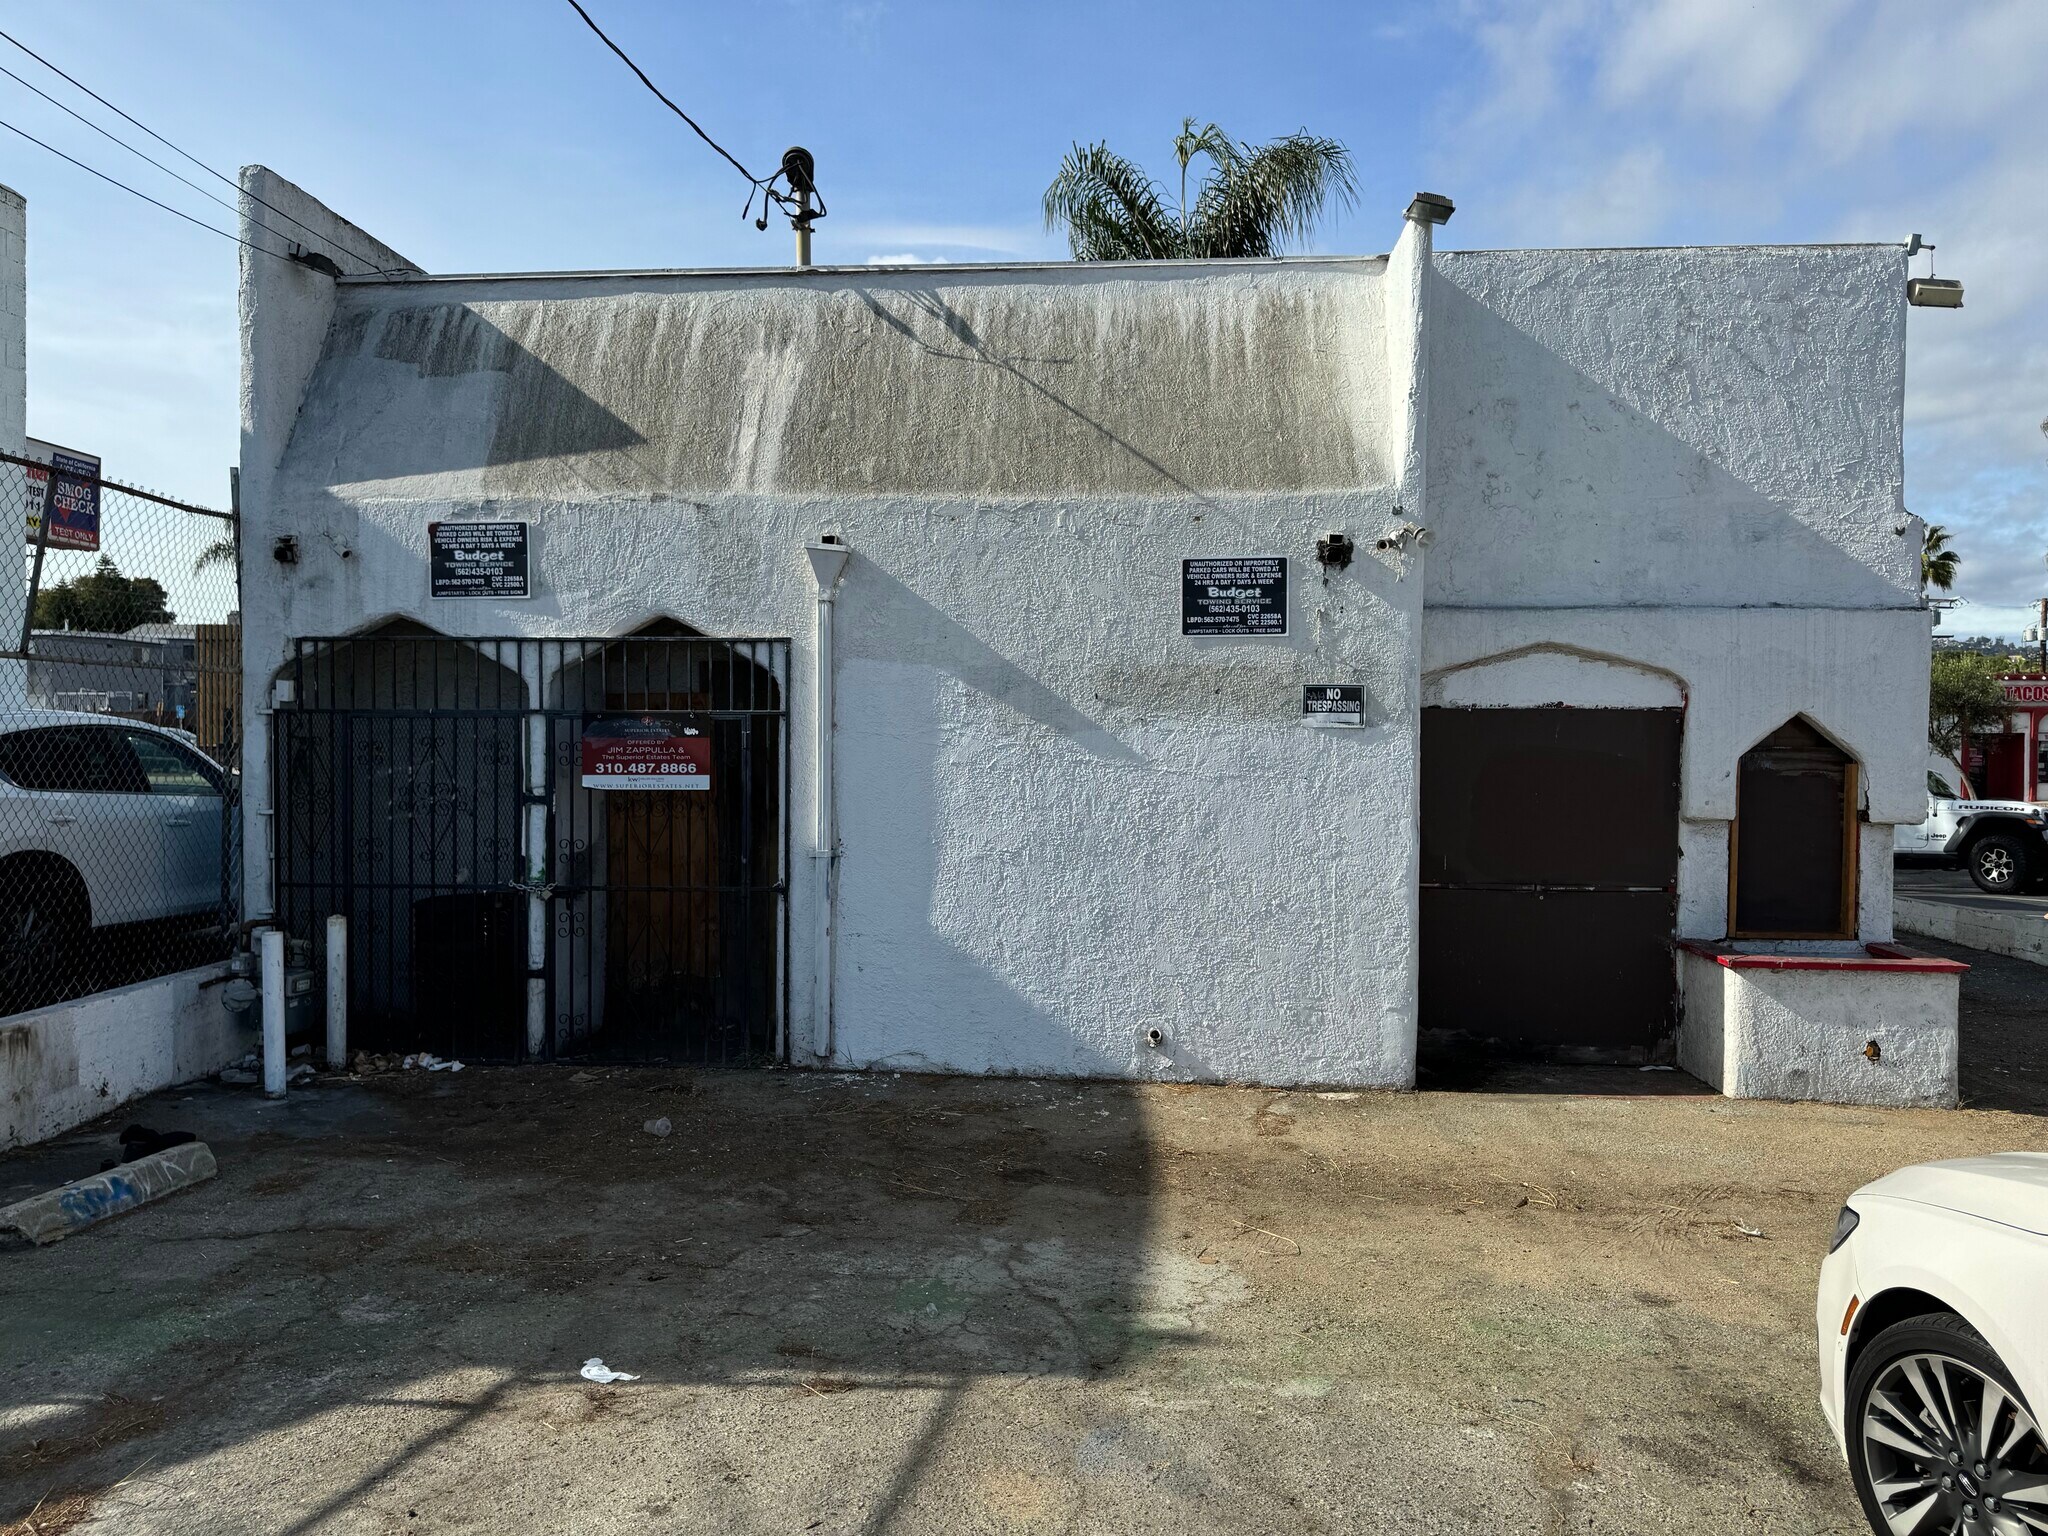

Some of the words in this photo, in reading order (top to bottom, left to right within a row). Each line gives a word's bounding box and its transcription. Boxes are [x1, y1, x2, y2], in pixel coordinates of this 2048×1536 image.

[74, 461, 95, 471] California
[58, 481, 91, 500] SMOG
[54, 494, 95, 515] CHECK
[55, 527, 73, 537] TEST
[75, 530, 93, 541] ONLY
[454, 550, 504, 562] Budget
[1208, 587, 1261, 599] Budget
[1327, 688, 1341, 700] NO
[1307, 700, 1360, 712] TRESPASSING
[596, 763, 696, 773] 310.487.8866
